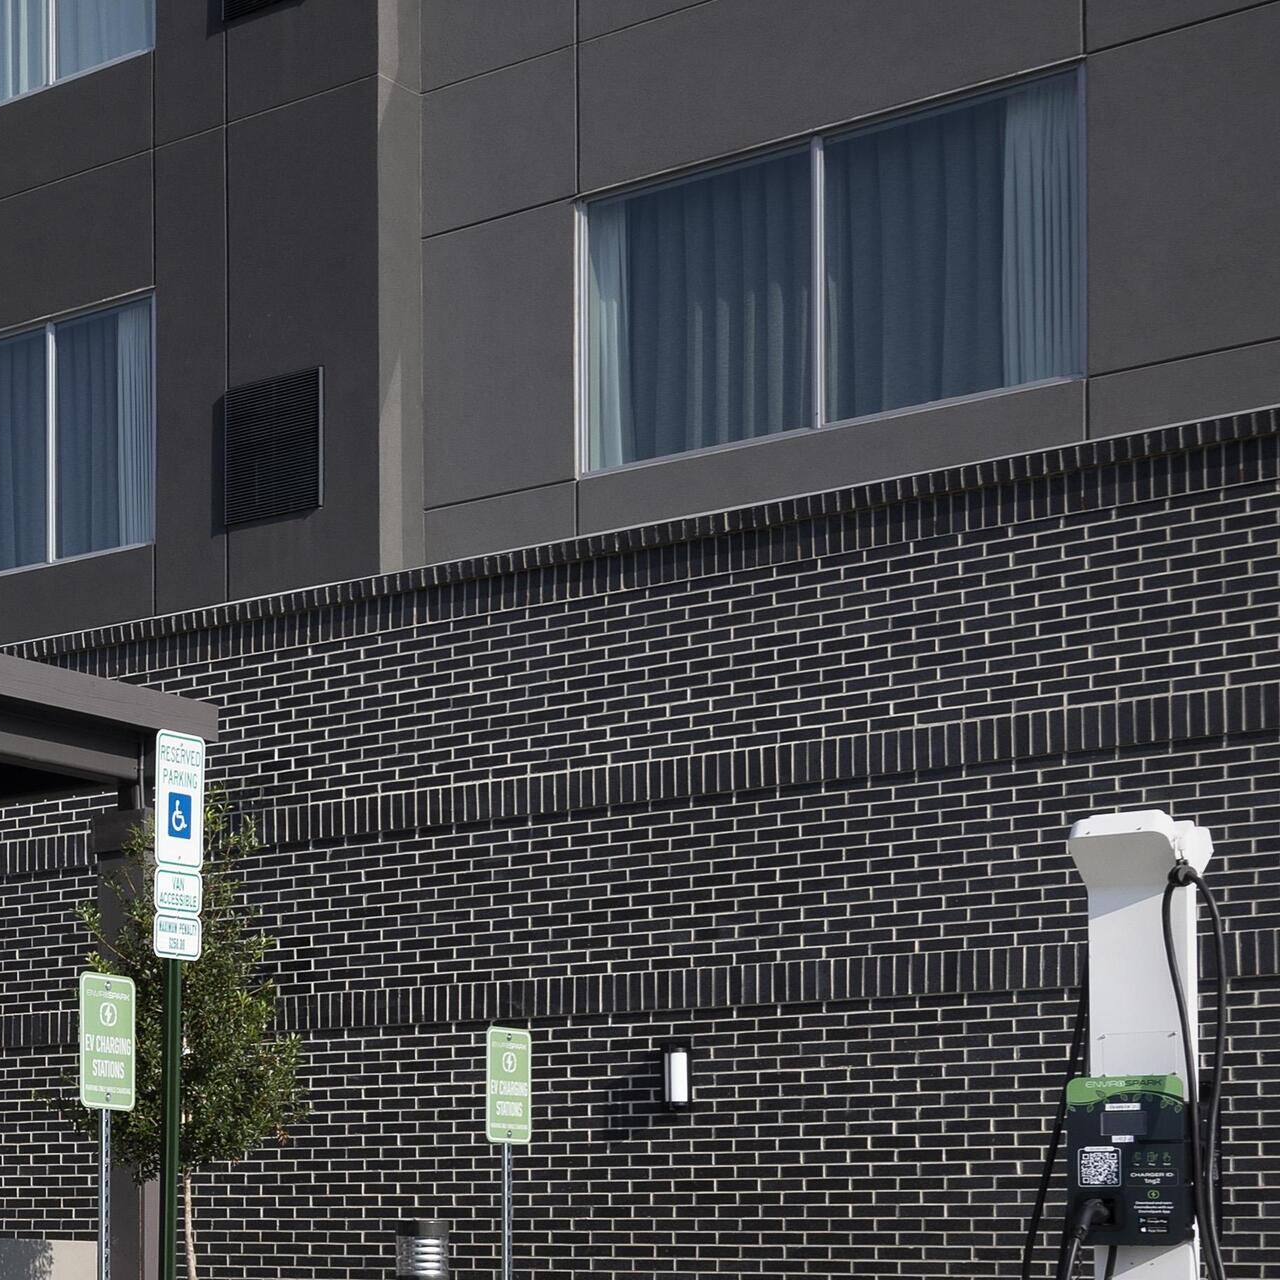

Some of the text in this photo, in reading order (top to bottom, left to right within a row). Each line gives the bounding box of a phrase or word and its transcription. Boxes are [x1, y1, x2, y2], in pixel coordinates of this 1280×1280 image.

[160, 744, 200, 767] RESERVED
[162, 767, 197, 789] PARKING
[172, 877, 185, 891] VAN
[159, 892, 197, 908] ACCESSIBLE
[85, 1033, 132, 1056] EV CHARGING
[92, 1059, 125, 1080] STATIONS
[490, 1079, 528, 1097] EV CHARGING
[1084, 1079, 1163, 1089] ENVIROSPARK
[495, 1101, 523, 1117] STATIONS
